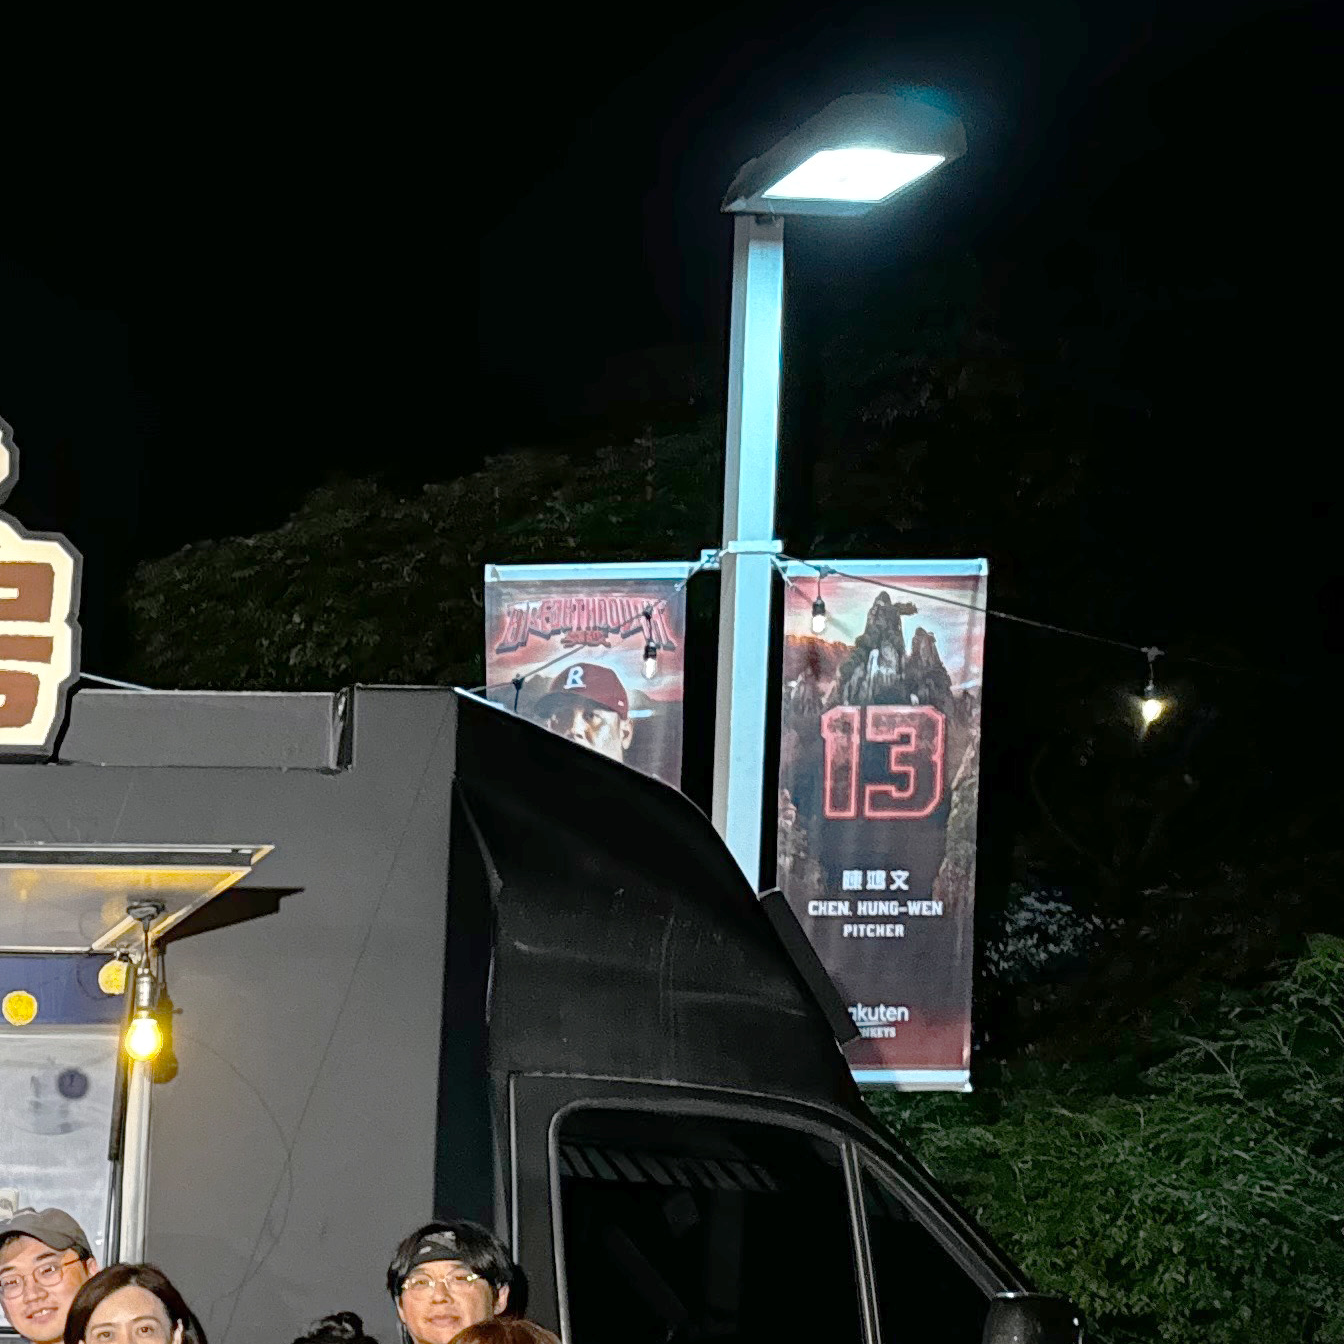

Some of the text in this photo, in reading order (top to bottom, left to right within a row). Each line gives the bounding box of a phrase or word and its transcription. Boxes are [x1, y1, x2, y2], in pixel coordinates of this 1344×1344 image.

[822, 705, 946, 819] 13
[857, 900, 943, 917] HUNG-WEN
[843, 923, 905, 938] PITCHER
